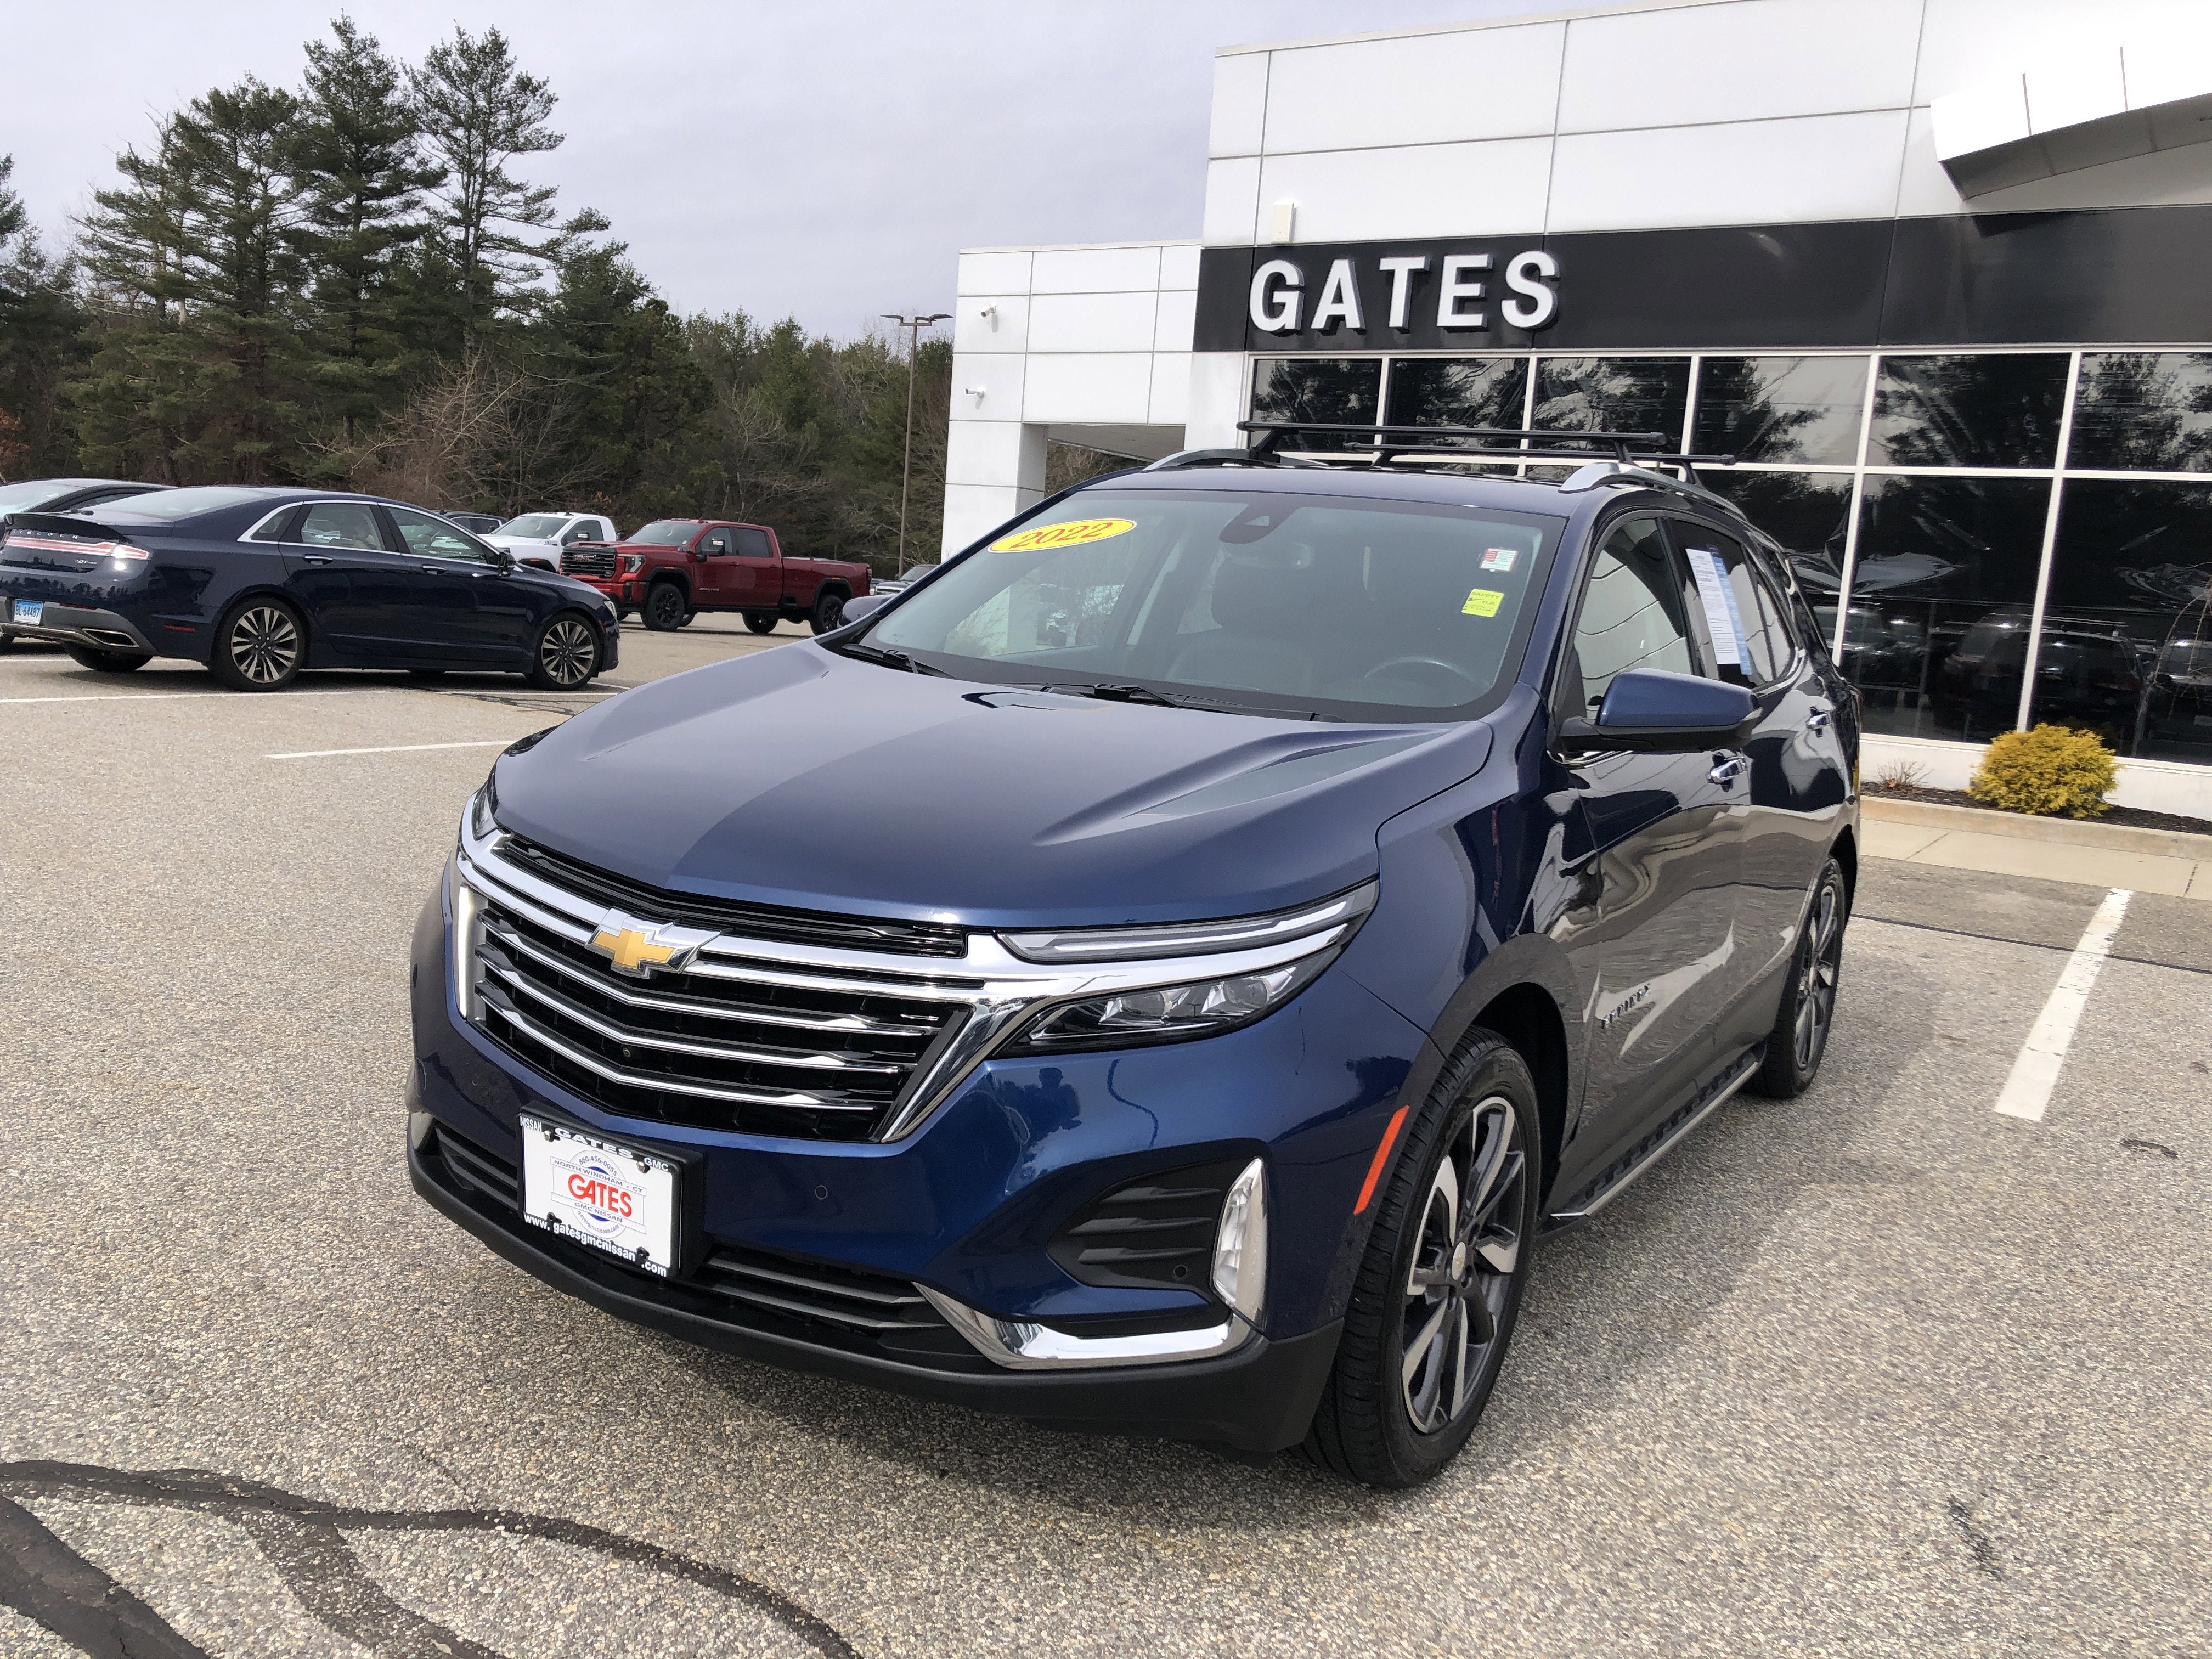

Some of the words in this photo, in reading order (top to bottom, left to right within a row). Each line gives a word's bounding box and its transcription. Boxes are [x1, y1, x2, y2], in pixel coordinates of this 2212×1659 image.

[1249, 250, 1560, 332] GATES
[1008, 522, 1113, 549] 2022
[520, 1115, 542, 1132] NISSAN
[554, 1128, 633, 1159] GATES
[554, 1159, 582, 1172] NORTH
[583, 1169, 623, 1186] WINDHAM
[578, 1155, 618, 1176] 860-456-0055
[644, 1157, 669, 1171] GMC
[567, 1173, 633, 1217] GATES
[574, 1201, 594, 1211] GMC
[594, 1208, 623, 1223] NISSAN
[577, 1210, 619, 1234] gatesgmcnissan.com
